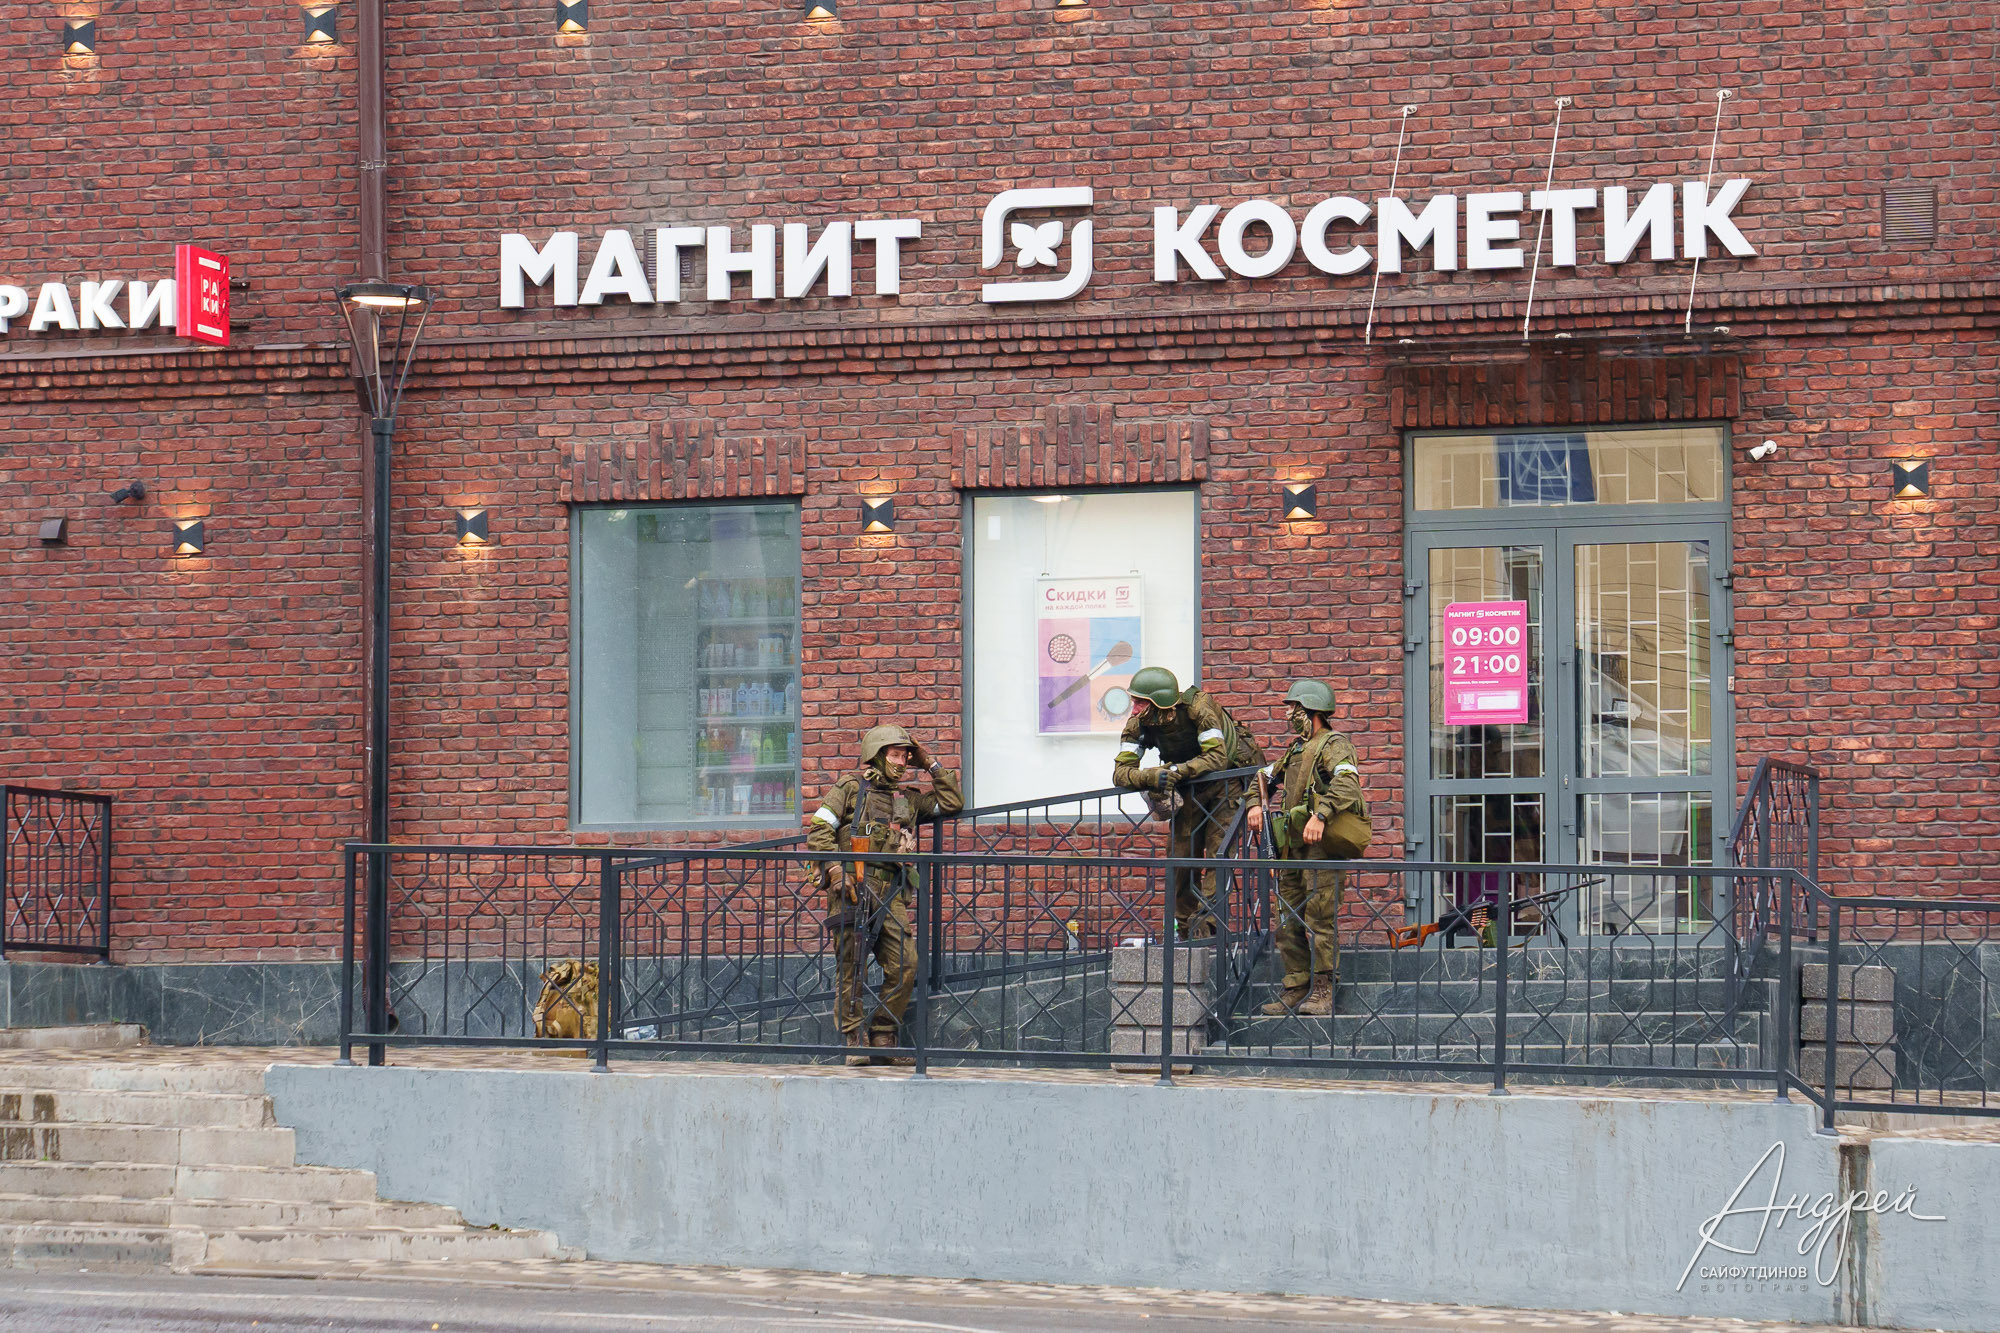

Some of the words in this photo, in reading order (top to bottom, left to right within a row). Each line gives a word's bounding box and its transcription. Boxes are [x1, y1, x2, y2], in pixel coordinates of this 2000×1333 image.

[500, 218, 921, 308] МАГНИТ
[1153, 178, 1759, 282] КОСМЕТИК
[1045, 588, 1106, 602] Скидки
[1452, 627, 1520, 646] 09:00
[1453, 655, 1520, 675] 21:00
